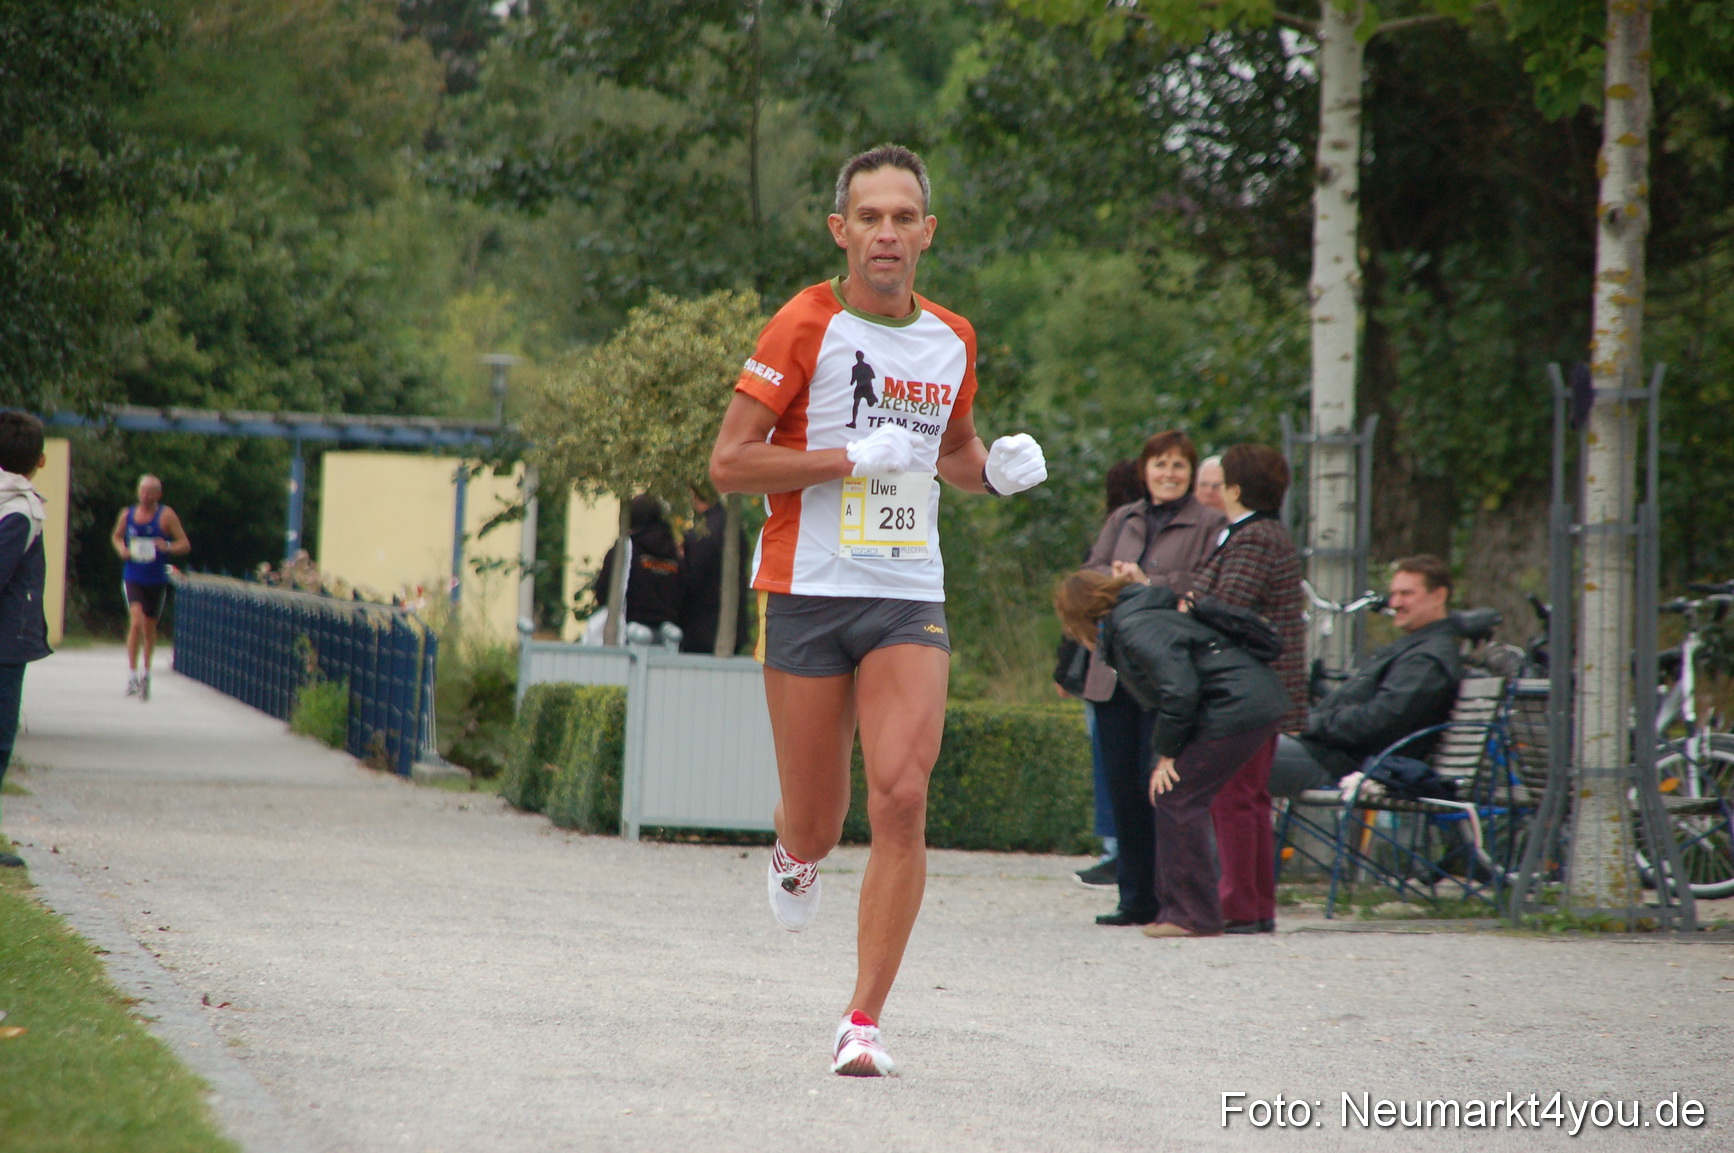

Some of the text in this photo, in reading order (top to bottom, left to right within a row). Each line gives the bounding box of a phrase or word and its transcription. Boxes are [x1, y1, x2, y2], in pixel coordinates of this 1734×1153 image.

[743, 357, 785, 387] MERZ
[884, 376, 952, 405] MERZ
[878, 391, 940, 417] Reisen
[912, 421, 941, 436] 2008
[870, 478, 897, 496] Uwe
[845, 504, 853, 516] A
[879, 507, 916, 530] 283
